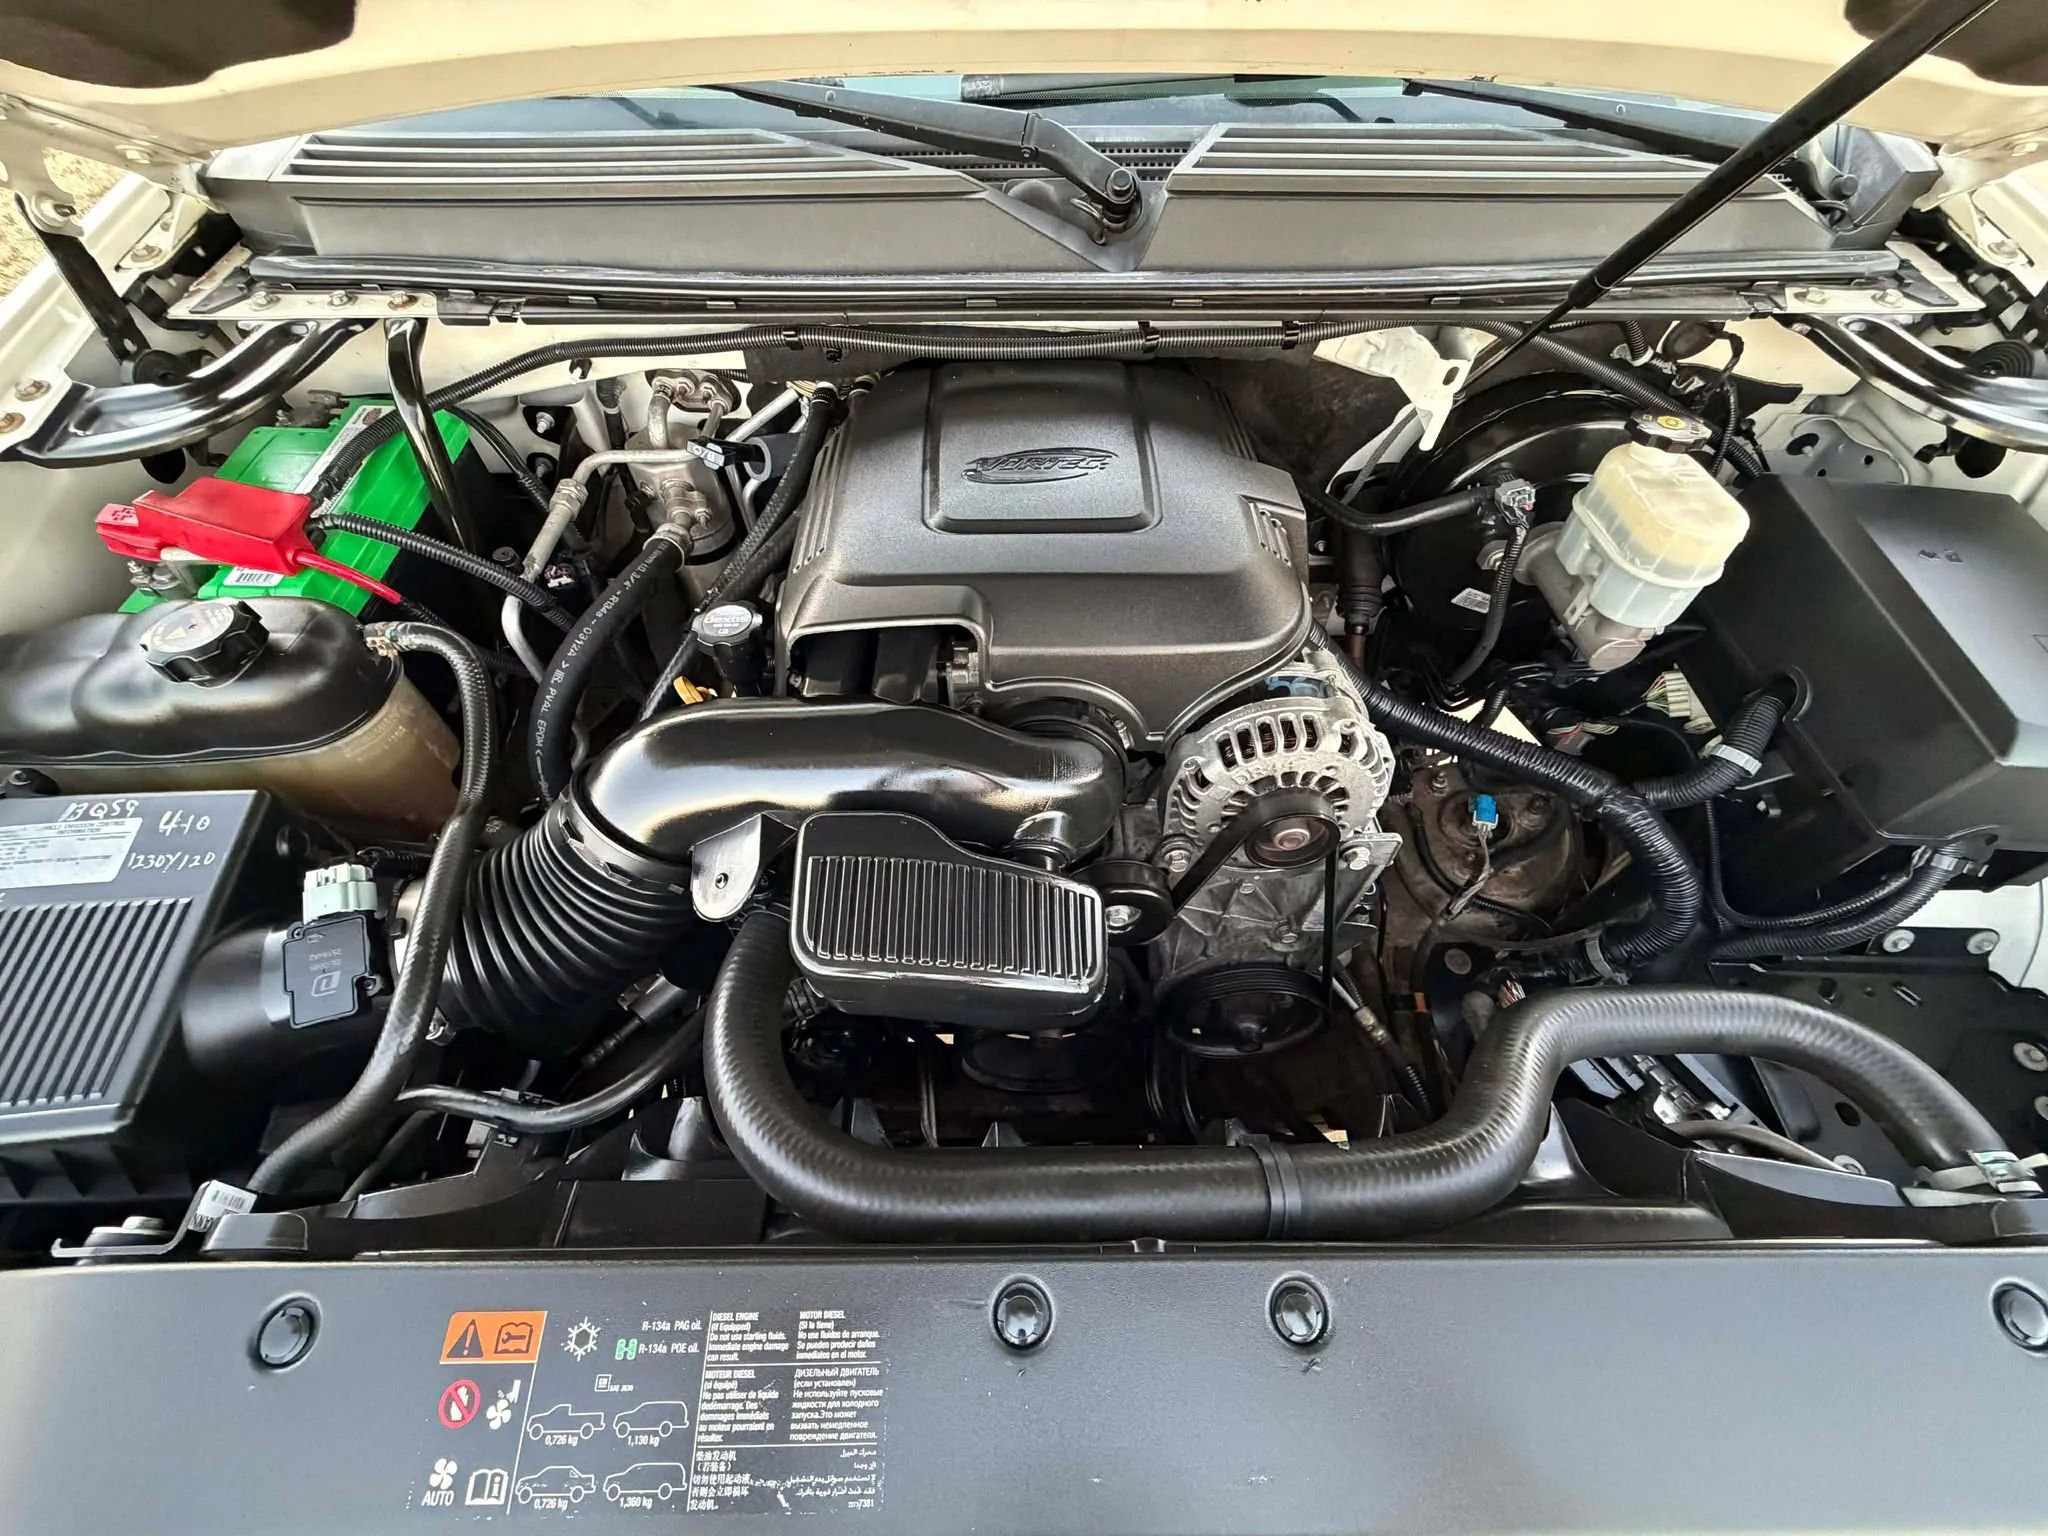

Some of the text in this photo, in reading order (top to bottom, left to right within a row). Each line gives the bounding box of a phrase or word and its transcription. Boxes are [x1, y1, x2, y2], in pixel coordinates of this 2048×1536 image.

[713, 1312, 759, 1321] DIESEL ENGINE
[800, 1310, 846, 1320] MOTOR DIESEL
[642, 1320, 671, 1331] R-134a
[674, 1320, 690, 1331] PAG
[719, 1322, 751, 1332] Equipped)
[710, 1333, 718, 1341] Do
[719, 1333, 730, 1341] not
[743, 1332, 767, 1342] starting
[842, 1330, 850, 1339] de
[638, 1343, 667, 1354] R-134a
[671, 1343, 687, 1353] POE
[742, 1342, 763, 1352] engine
[797, 1340, 805, 1349] Se
[705, 1369, 756, 1379] MOTEUR DIESEL
[794, 1367, 880, 1378] ДИЗЕЛЬНЫЙ ДВИГАТЕЛЬ
[712, 1392, 725, 1401] pas
[748, 1390, 757, 1399] de
[793, 1389, 803, 1398] Не
[745, 1401, 758, 1410] Des
[567, 1435, 578, 1446] kg
[649, 1435, 660, 1447] kg
[421, 1490, 455, 1506] AUTO
[557, 1498, 568, 1510] kg
[642, 1498, 652, 1509] kg
